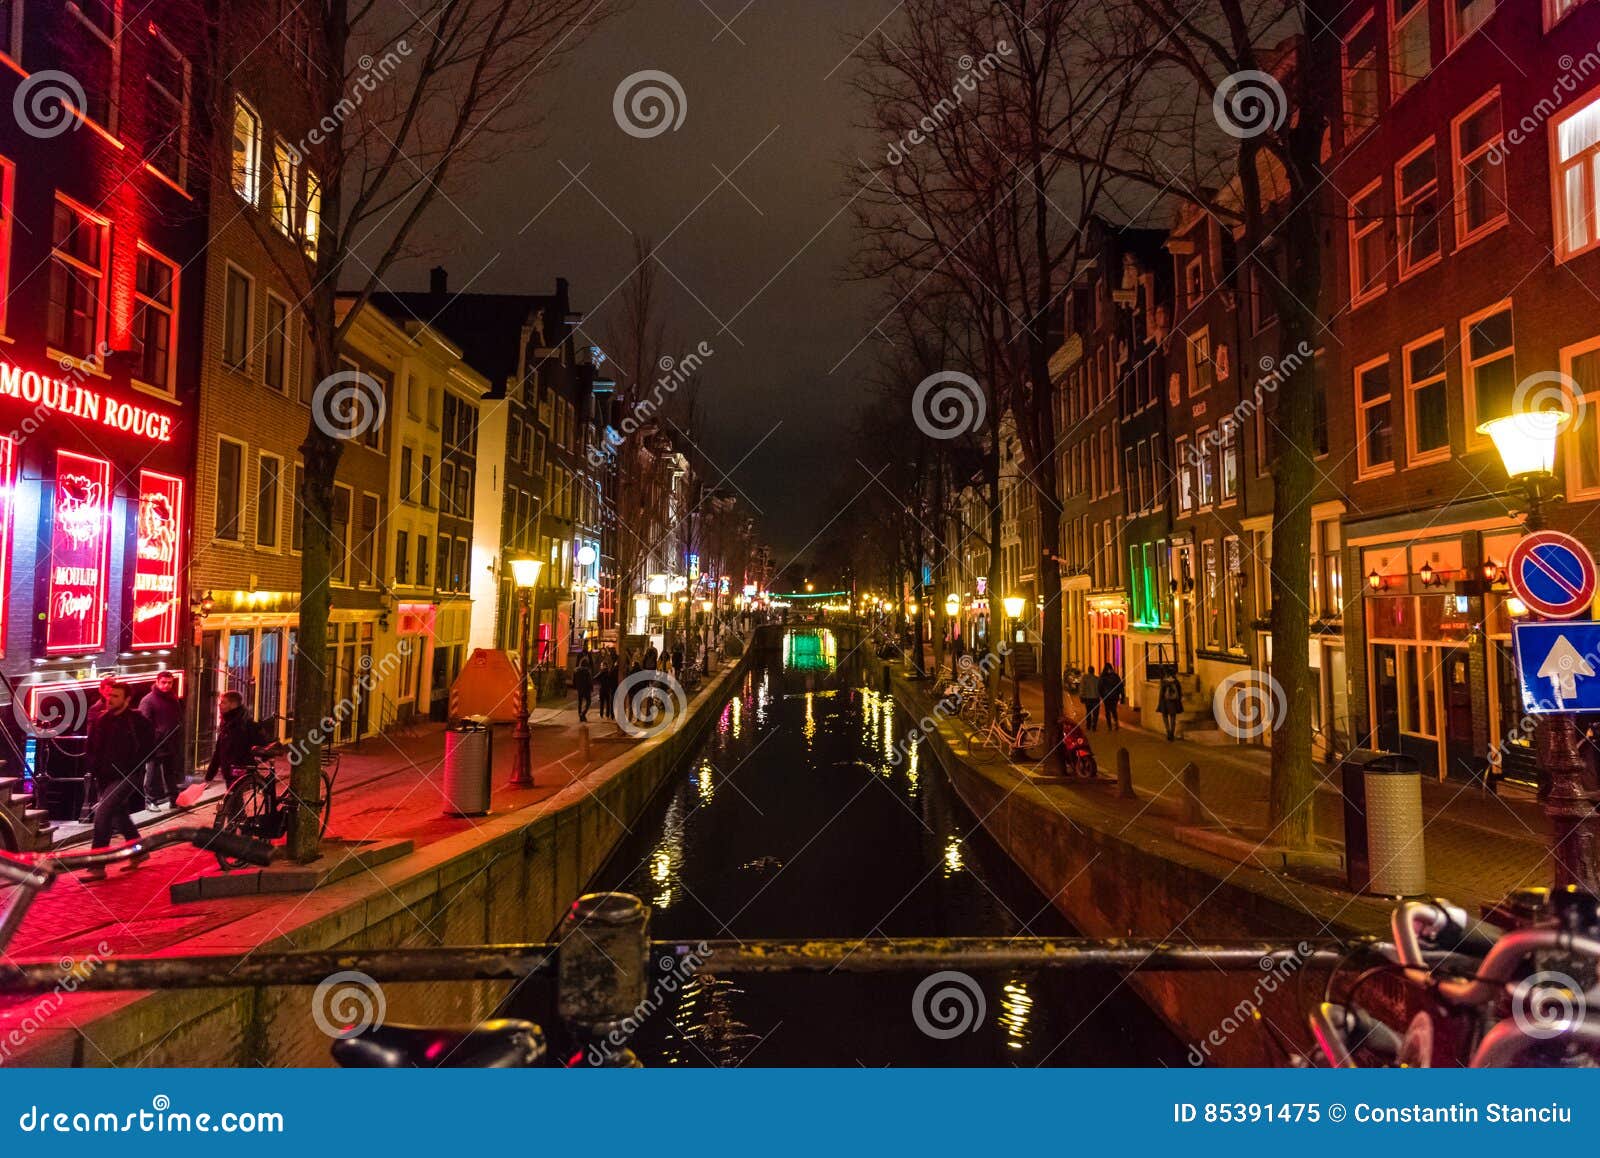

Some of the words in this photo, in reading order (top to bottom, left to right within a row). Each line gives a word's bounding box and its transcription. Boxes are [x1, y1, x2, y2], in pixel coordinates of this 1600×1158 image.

[0, 361, 101, 421] MOULIN
[103, 396, 171, 442] ROUGE
[55, 566, 98, 586] MOULIN
